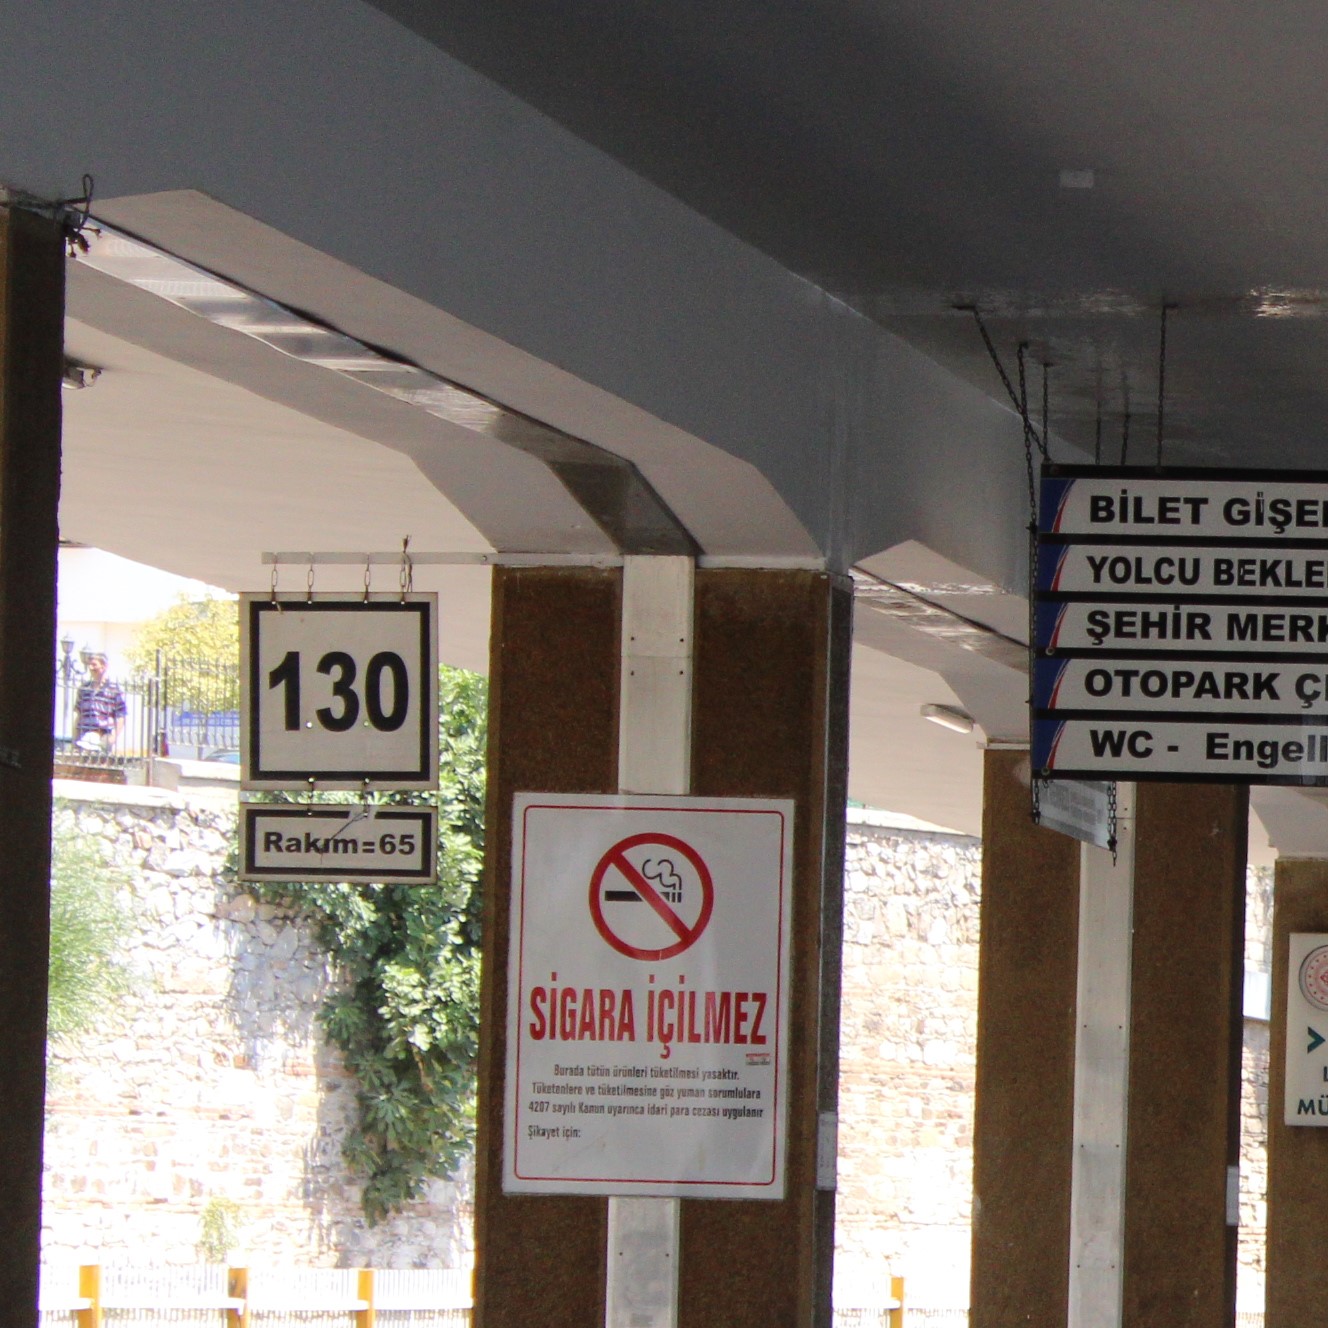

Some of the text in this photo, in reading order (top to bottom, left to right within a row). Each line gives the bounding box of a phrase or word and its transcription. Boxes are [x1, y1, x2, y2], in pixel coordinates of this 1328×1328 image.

[1090, 489, 1208, 527] BİLET
[1087, 556, 1200, 587] YOLCU
[1086, 605, 1211, 645] ŞEHİR
[269, 651, 409, 732] 130
[1084, 669, 1279, 701] OTOPARK
[1090, 730, 1153, 759] WC
[263, 831, 415, 855] Rakım=65
[529, 972, 767, 1059] SİGARA İÇİLMEZ
[554, 1064, 739, 1081] Burada tütün ürünleri tüketilmesi yasaktır.
[532, 1082, 761, 1099] Tüketenlere ve tüketilmesine göz yuman sorumlulara
[529, 1101, 764, 1120] 4207 sayılı Kanun uyarınca idari para cezası uygulanır
[528, 1125, 580, 1140] Şikayet için:
